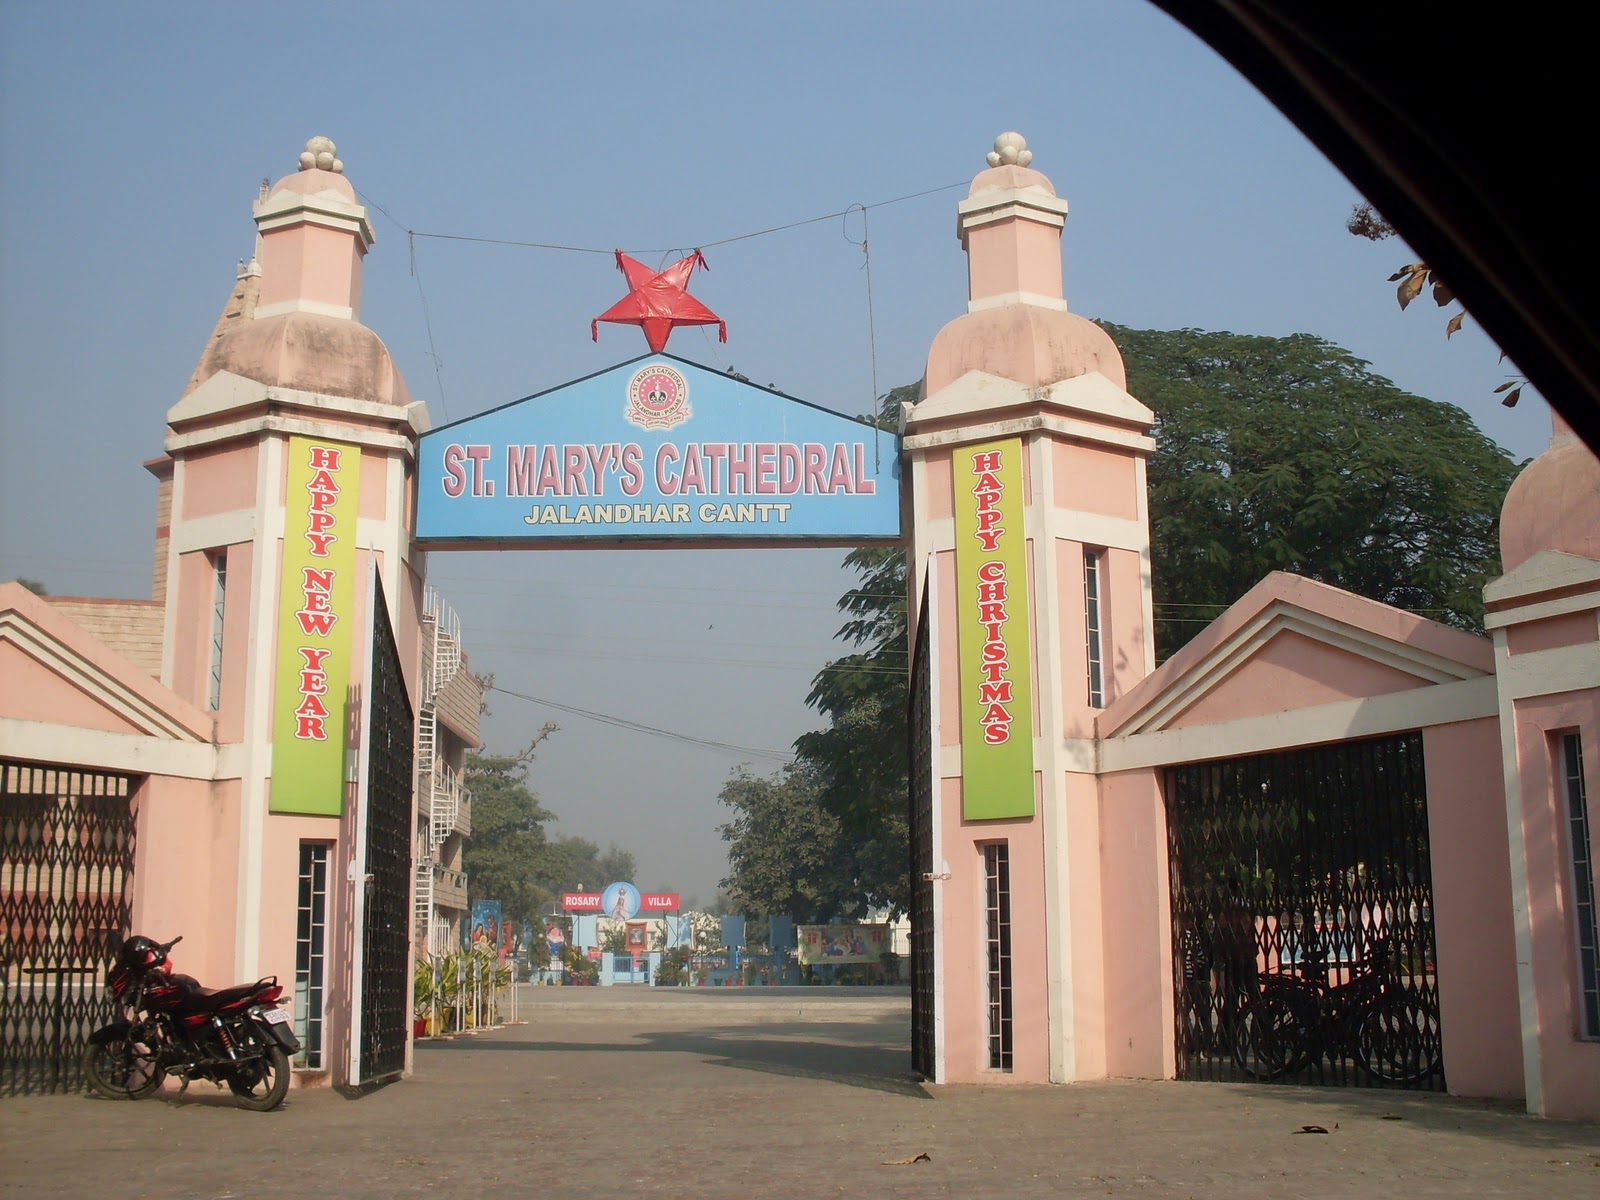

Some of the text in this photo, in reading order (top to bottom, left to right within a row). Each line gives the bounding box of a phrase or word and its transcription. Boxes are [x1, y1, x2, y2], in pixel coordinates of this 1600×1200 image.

[636, 368, 656, 381] MARY'S
[656, 368, 683, 390] CATHEDRAL
[634, 399, 682, 417] JALANDHAR PUNJAB
[442, 442, 876, 498] ST. MARY'S CATHEDRAL
[524, 503, 791, 525] JALANDHAR CANTT
[293, 445, 342, 741] HAPPY NEW YEAR
[971, 449, 1014, 745] HAPPY CHRISTMAS
[565, 896, 672, 906] ROSARY VILLA
